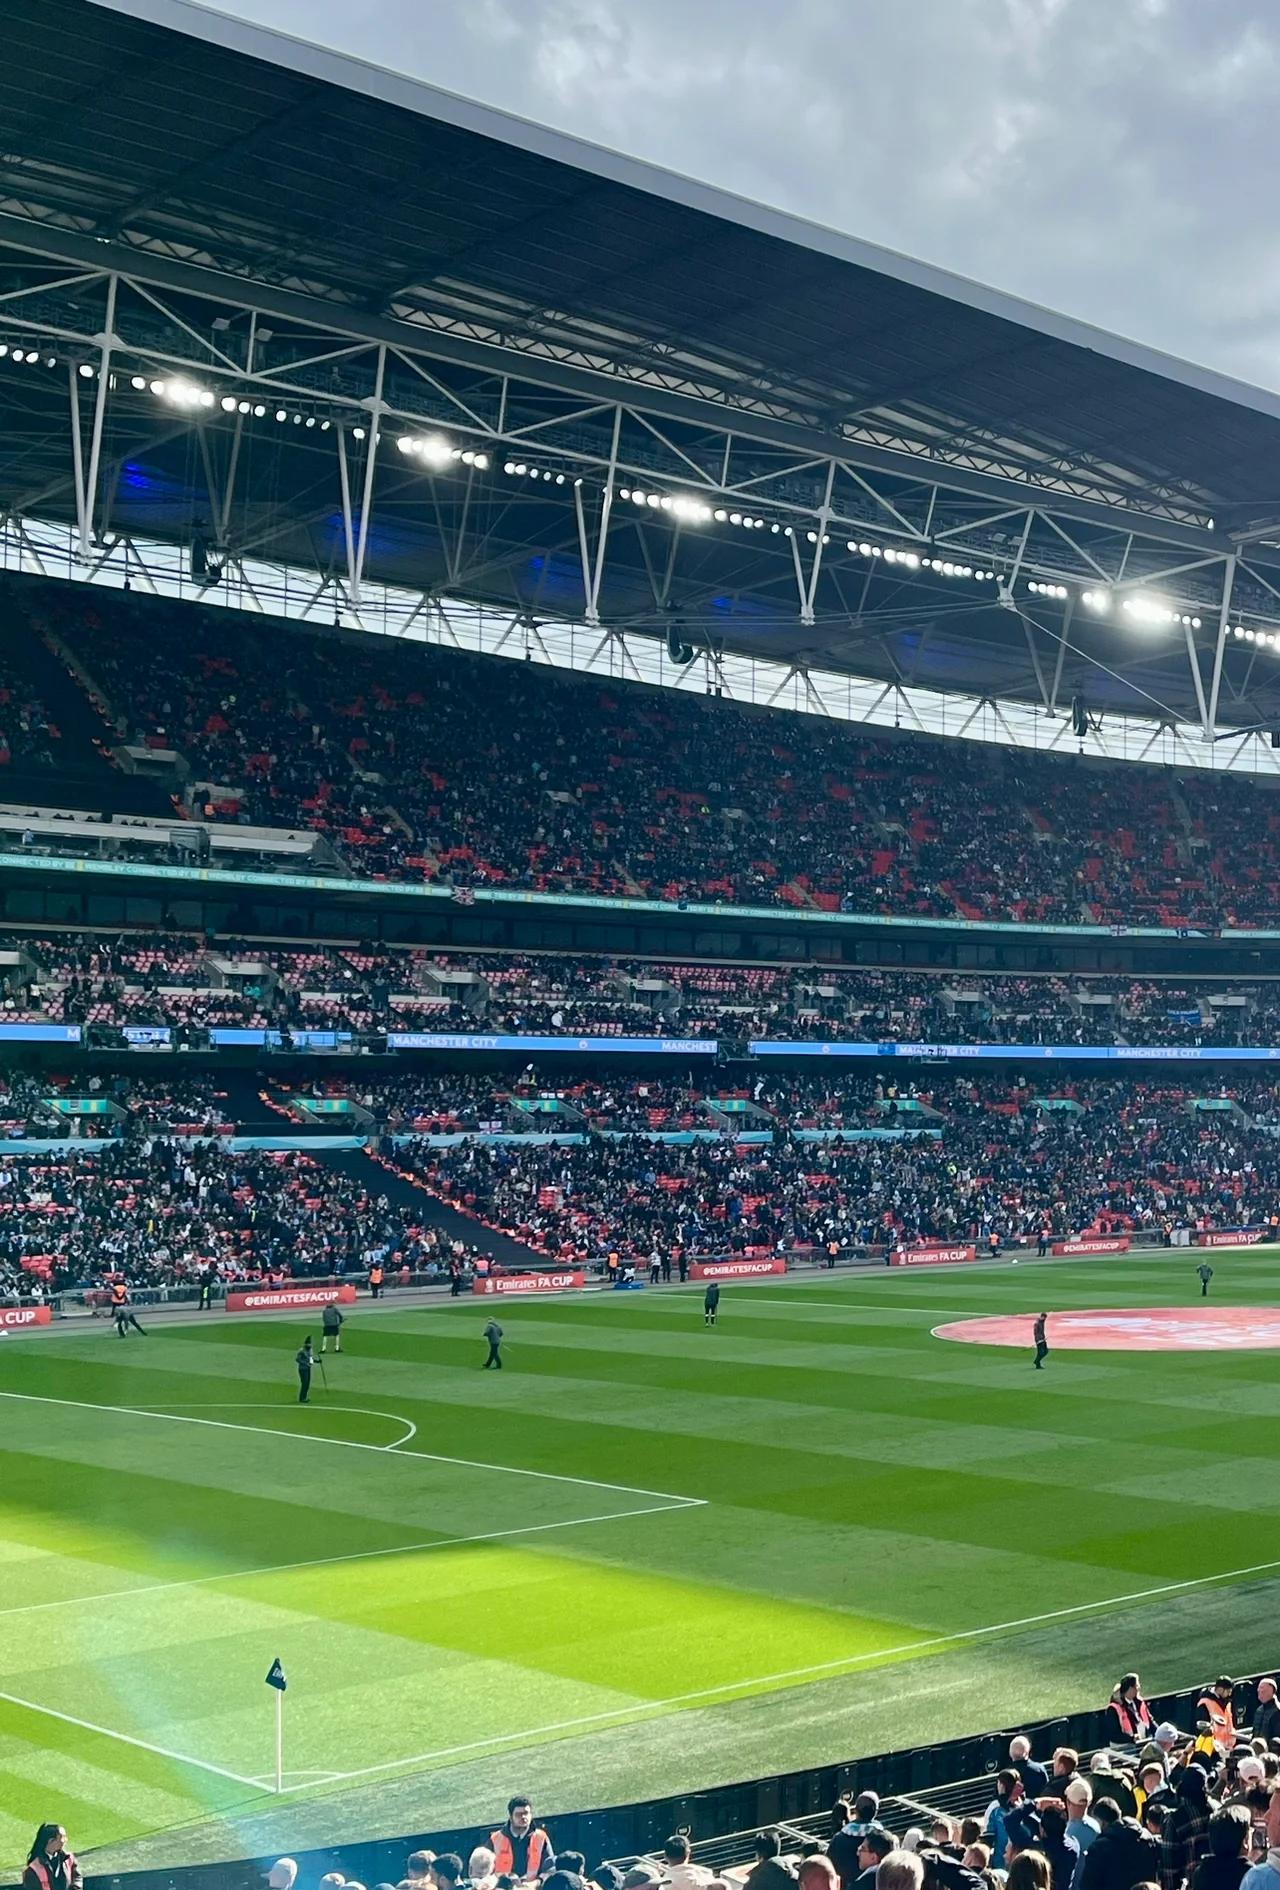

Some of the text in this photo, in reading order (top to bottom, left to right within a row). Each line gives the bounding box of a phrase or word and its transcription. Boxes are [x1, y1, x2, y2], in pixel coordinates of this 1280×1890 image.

[393, 1035, 498, 1048] MANCHESTER CITY
[661, 1041, 717, 1052] MANCHEST
[1117, 1048, 1201, 1057] MANCHESTER CITY
[907, 1251, 967, 1263] Emirates FA CUP
[703, 1263, 773, 1276] @EMIRATESFACUP
[496, 1275, 574, 1291] Emirates FA CUP
[244, 1291, 339, 1307] @EMIRATESFACUP
[5, 1311, 36, 1324] CUP
